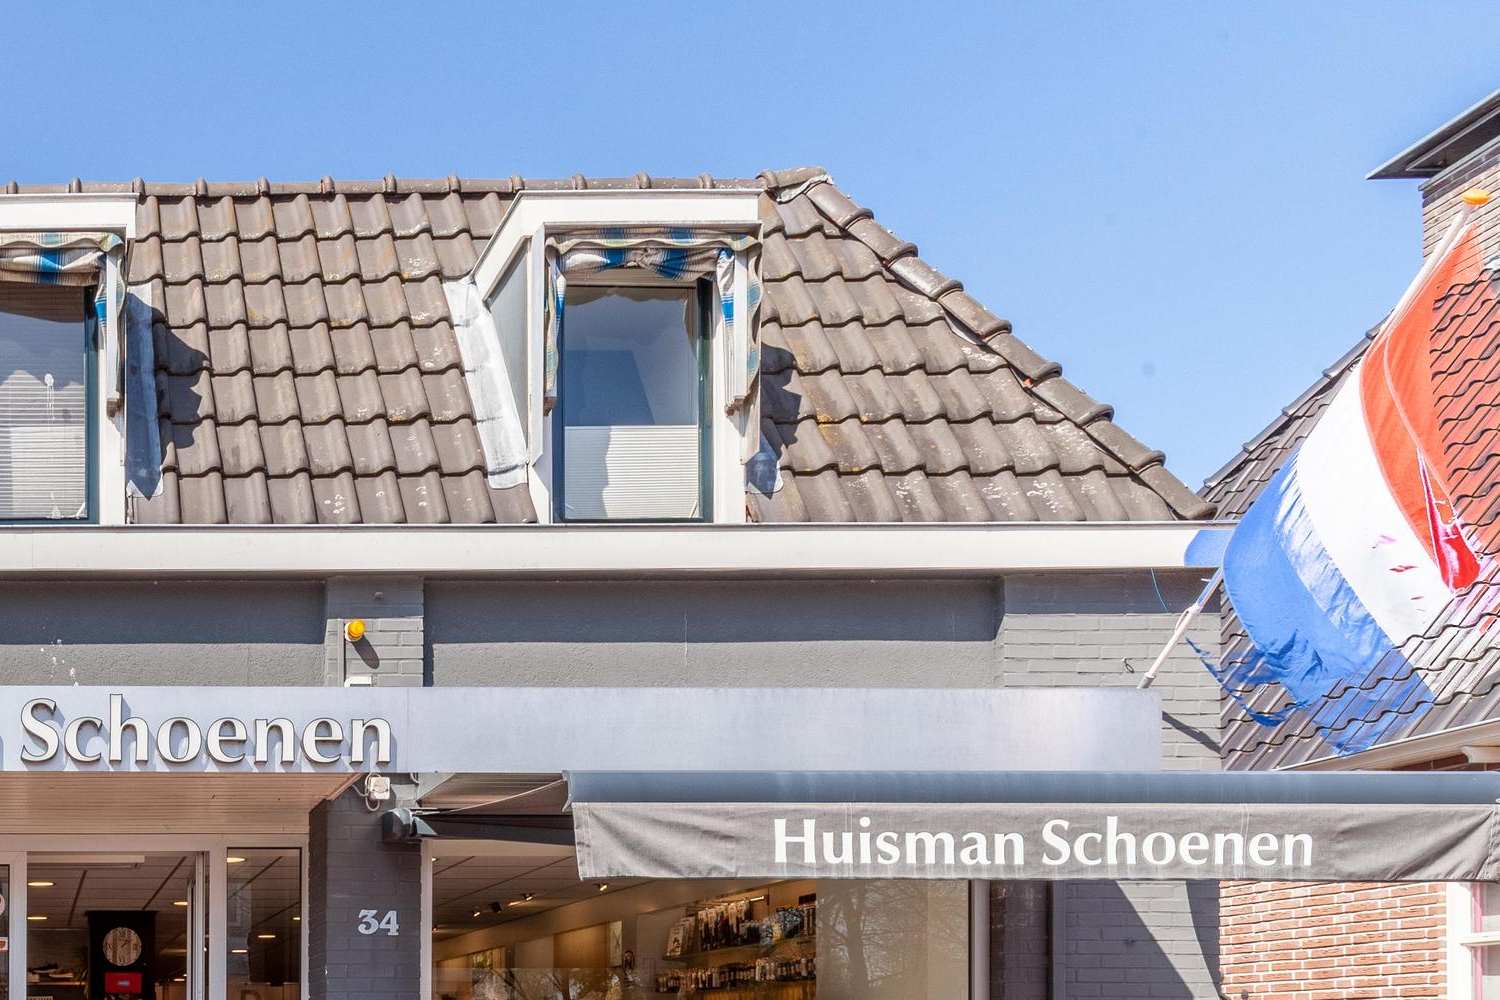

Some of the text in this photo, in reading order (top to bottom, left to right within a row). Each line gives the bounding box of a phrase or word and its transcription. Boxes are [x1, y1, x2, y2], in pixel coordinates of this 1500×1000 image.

[20, 693, 390, 764] Schoenen
[774, 816, 1313, 867] Huisman Schoenen
[358, 909, 399, 936] 34
